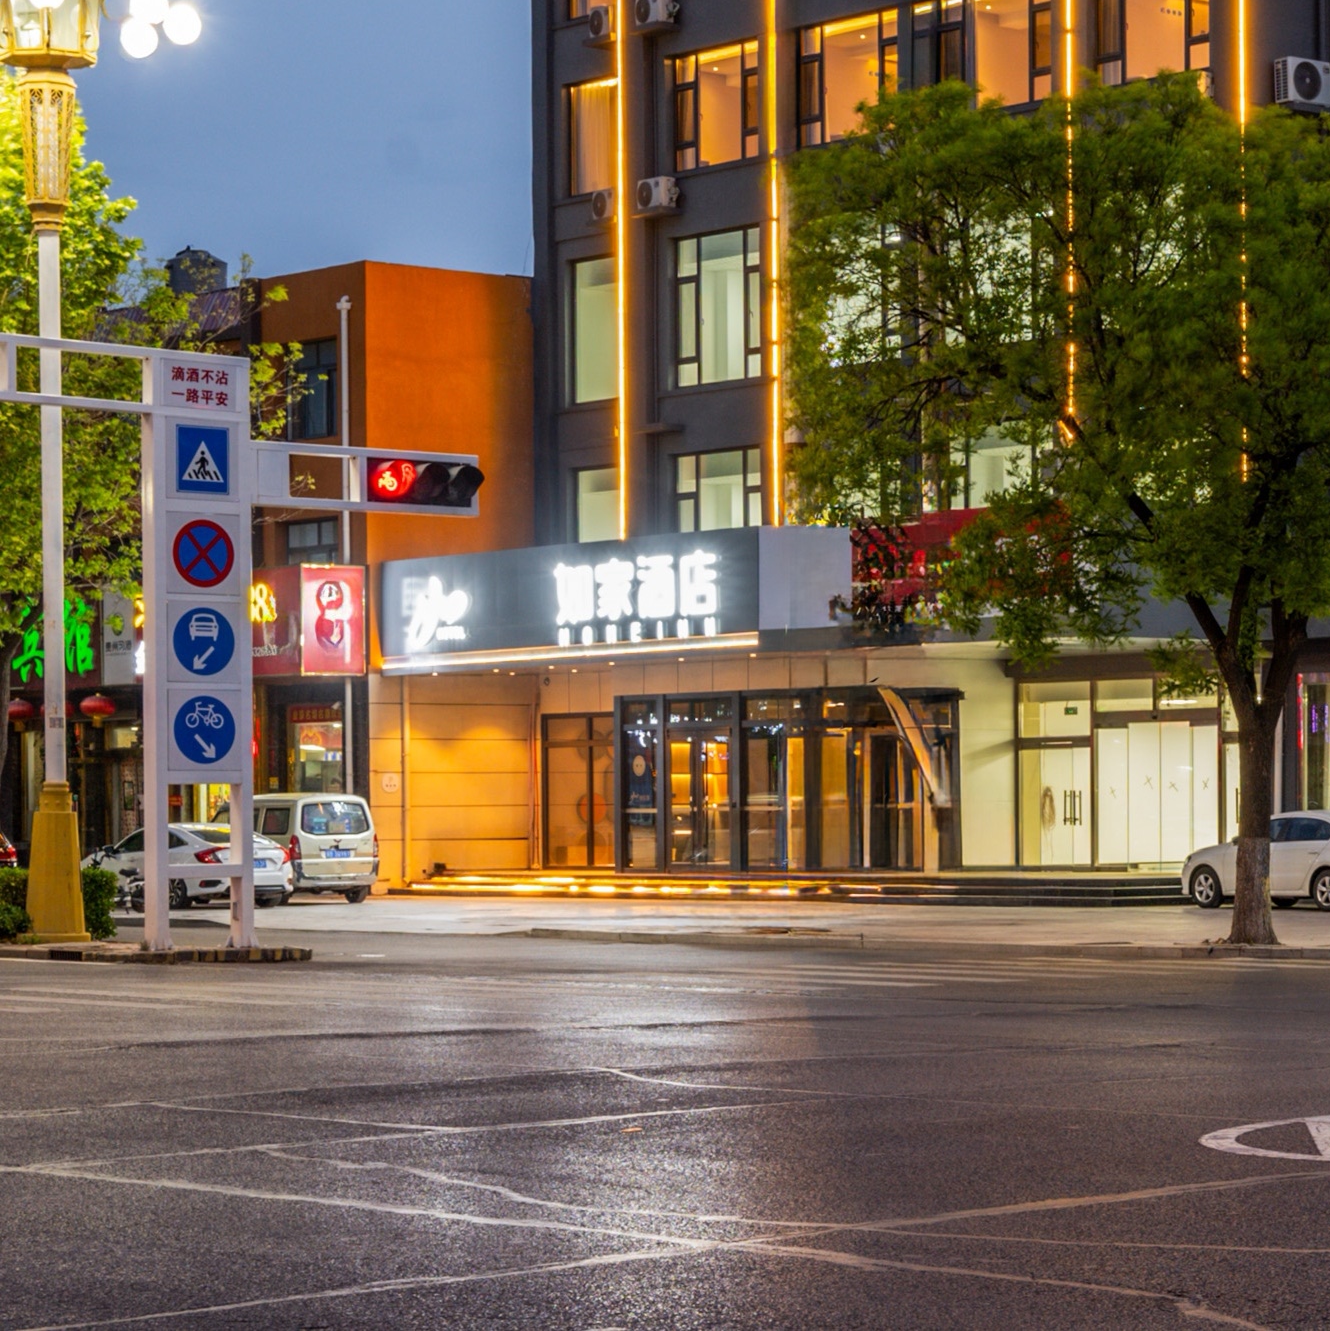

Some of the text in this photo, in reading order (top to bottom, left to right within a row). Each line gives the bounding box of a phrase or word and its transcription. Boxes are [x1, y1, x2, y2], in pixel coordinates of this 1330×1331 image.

[171, 366, 228, 385] 滴酒不沾
[171, 388, 228, 406] 一路平安
[553, 550, 718, 625] 如家酒店
